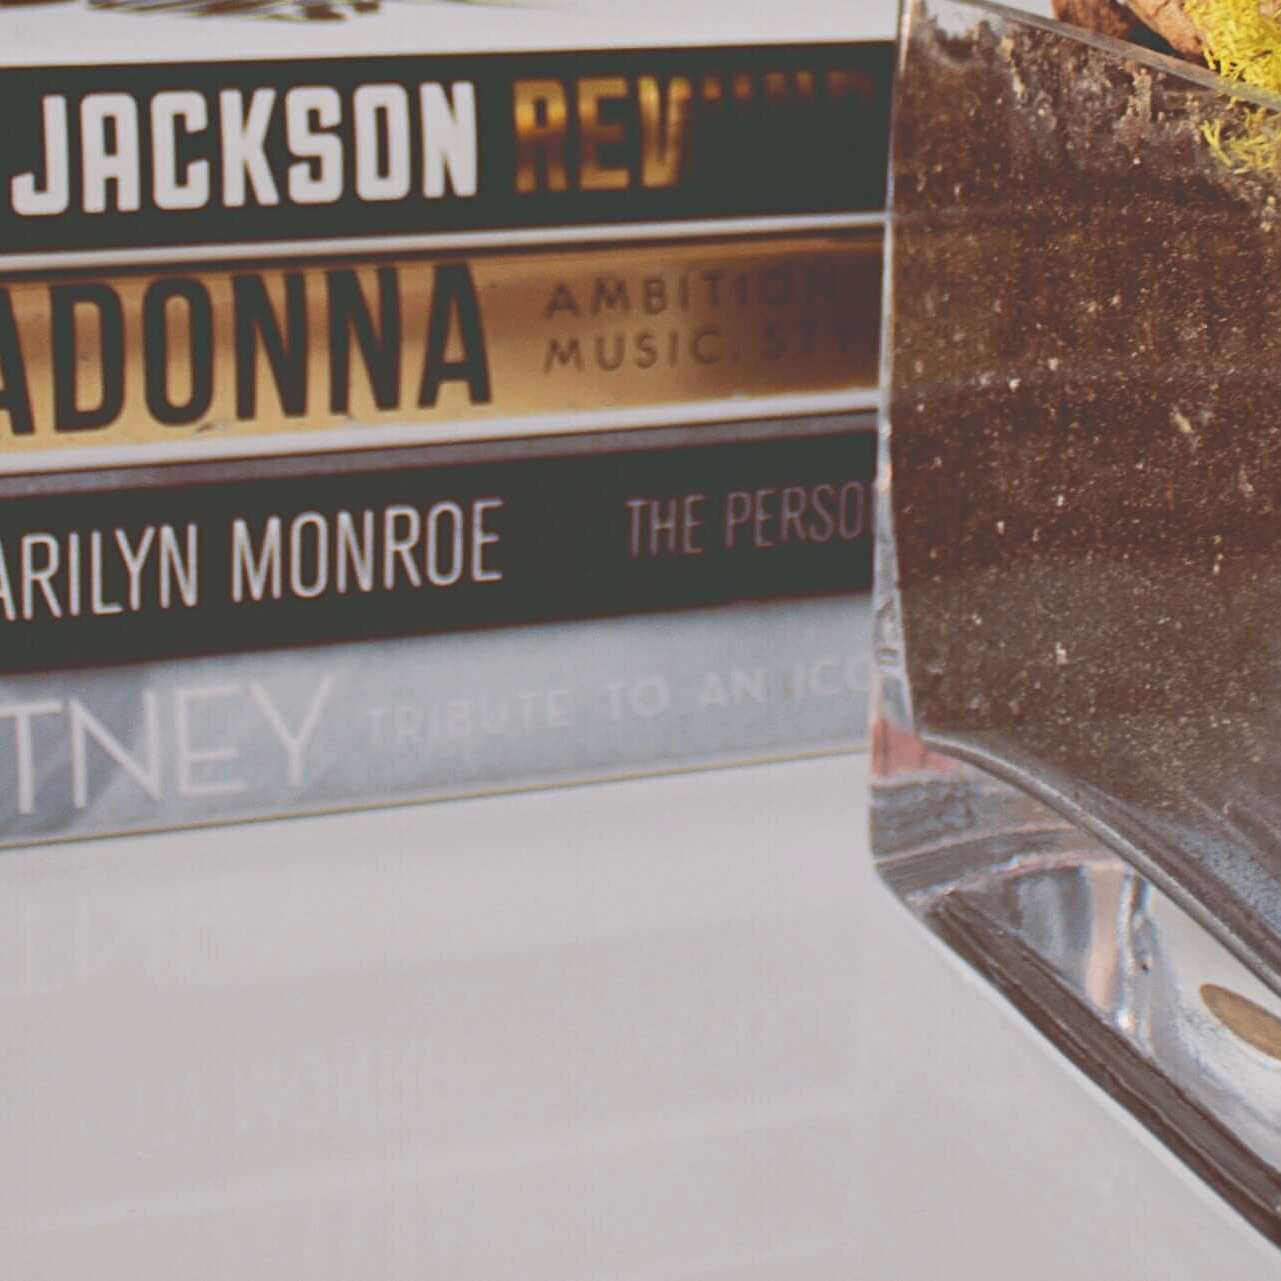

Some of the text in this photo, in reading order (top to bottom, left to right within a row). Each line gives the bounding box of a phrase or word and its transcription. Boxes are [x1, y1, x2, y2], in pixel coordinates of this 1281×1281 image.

[11, 80, 479, 217] JACKSON
[231, 498, 505, 603] MONROE
[624, 493, 707, 559] THE
[363, 686, 575, 746] TRIBUTE
[601, 673, 671, 719] TO
[698, 665, 768, 713] AN
